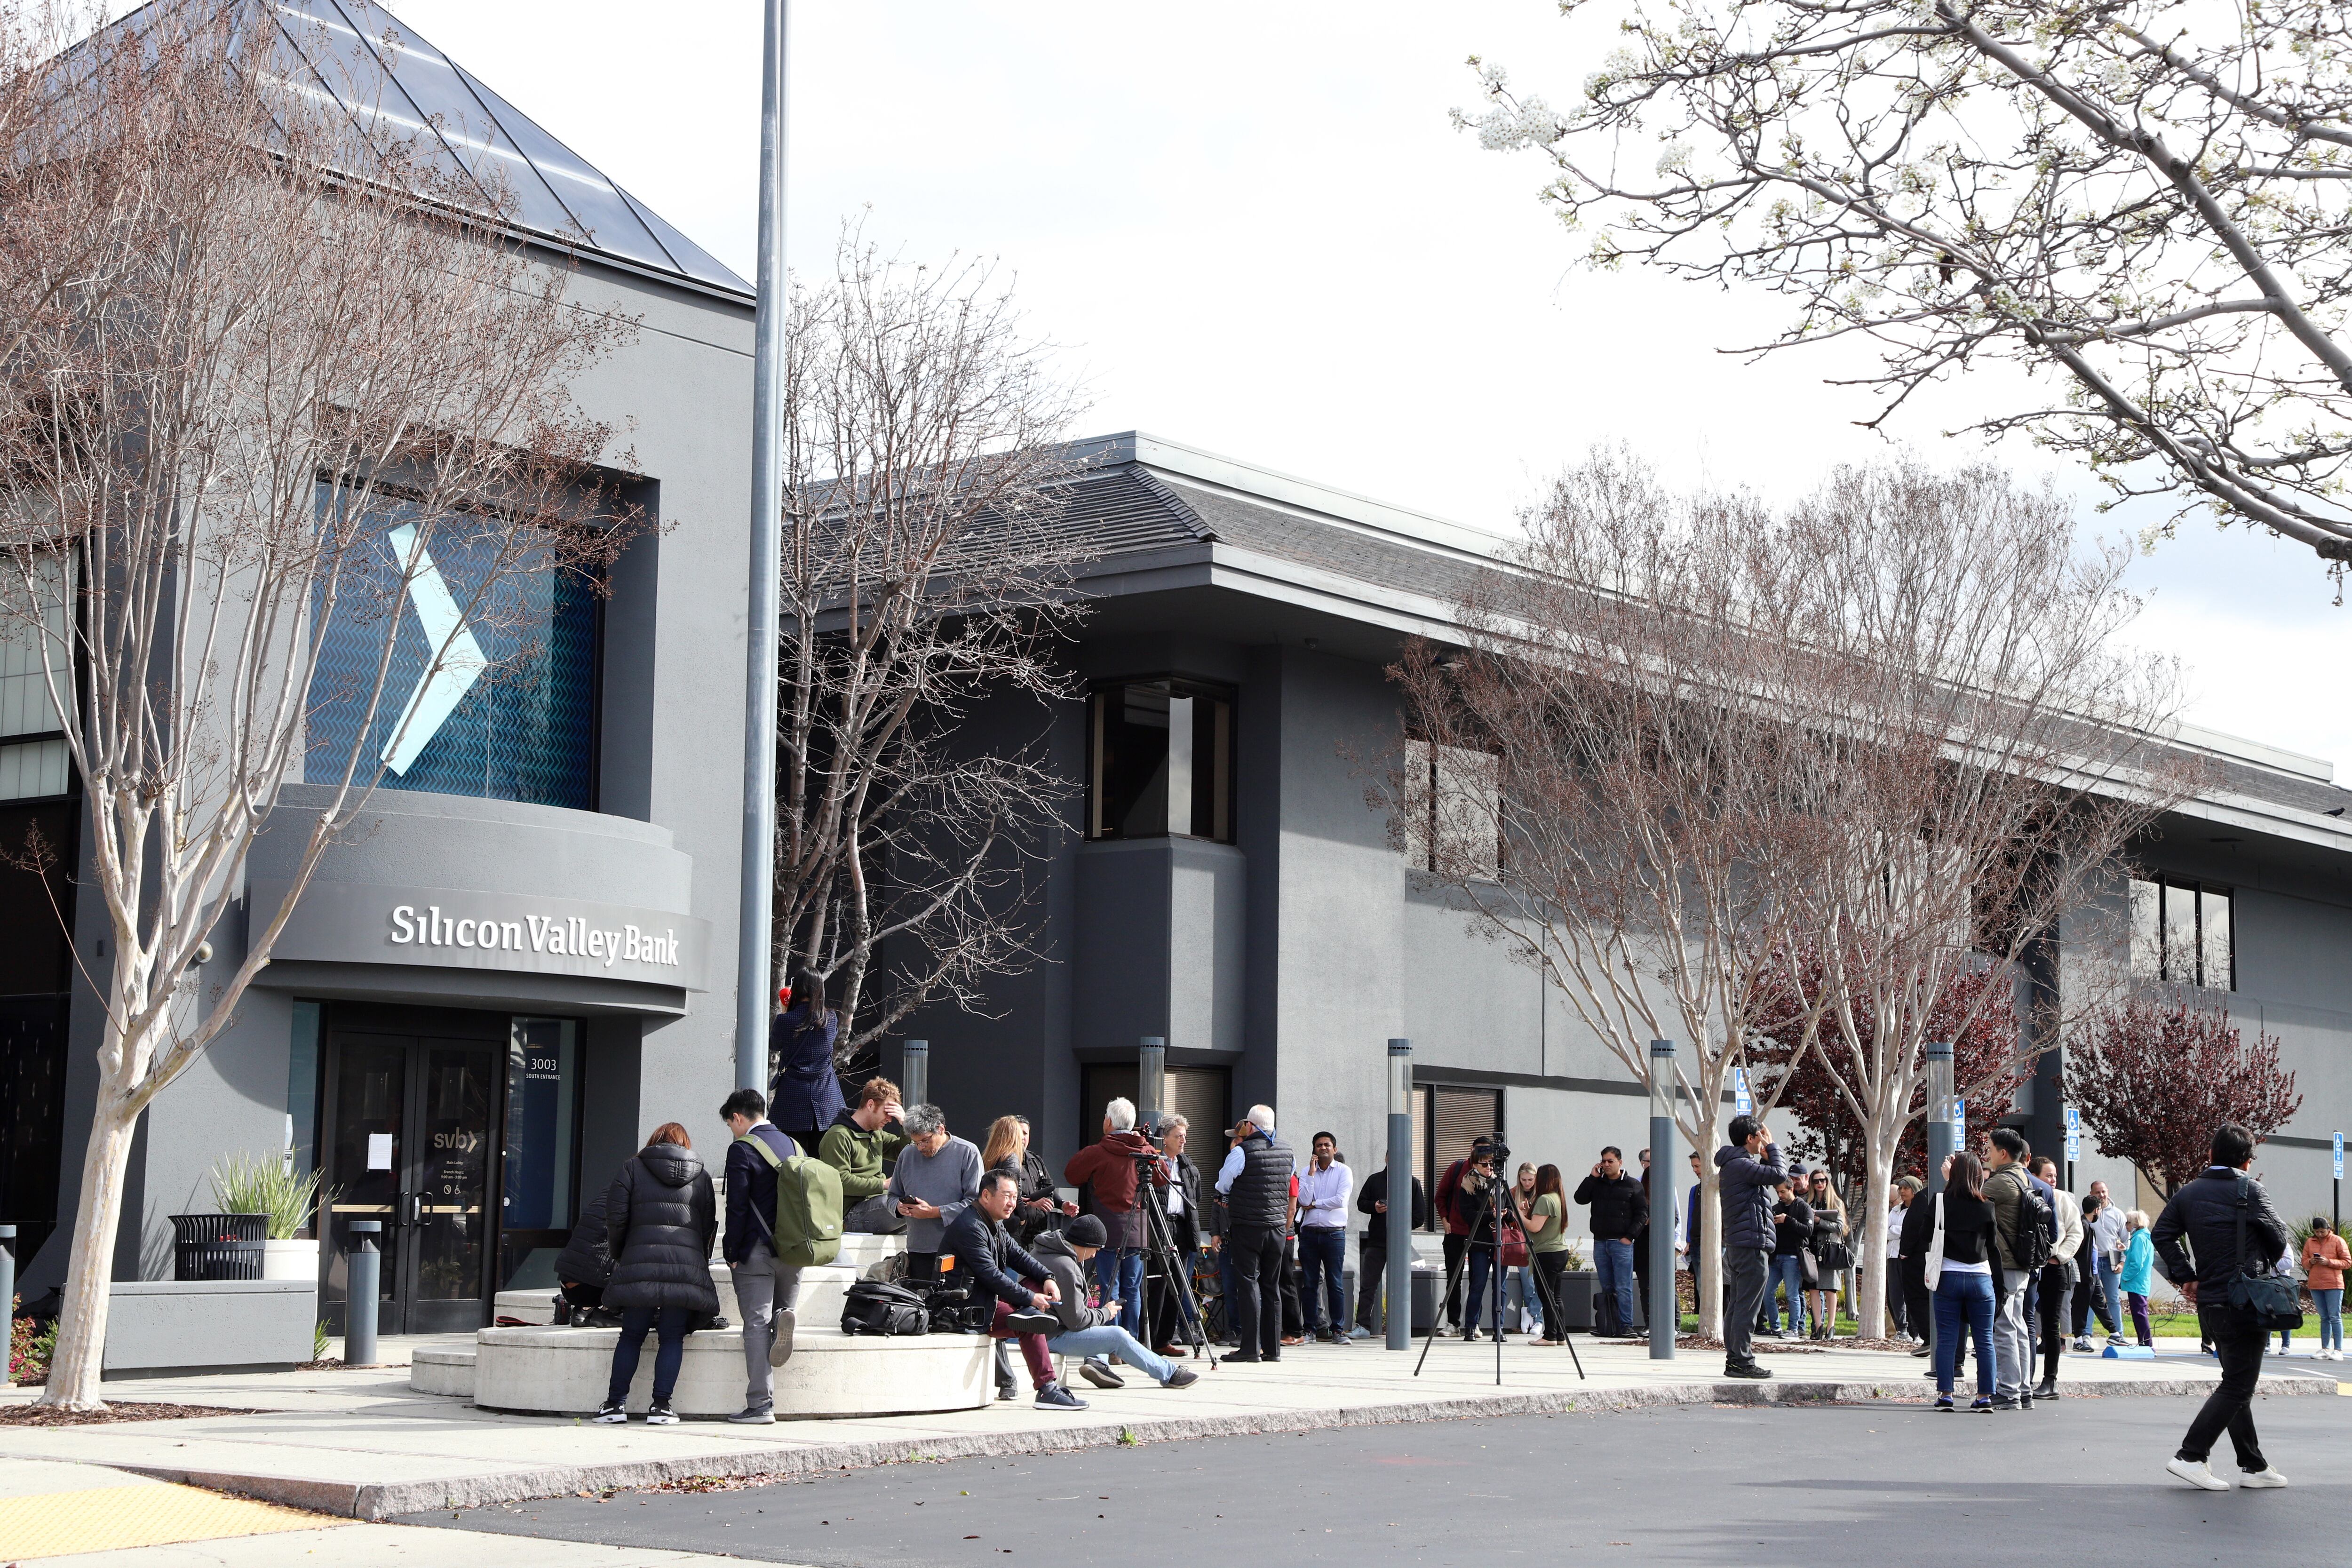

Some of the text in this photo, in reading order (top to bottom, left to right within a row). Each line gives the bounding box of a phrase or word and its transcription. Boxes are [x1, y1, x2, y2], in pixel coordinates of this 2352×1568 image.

[391, 906, 679, 968] Silicon Valley Bank
[531, 1059, 556, 1071] 3003
[434, 1127, 467, 1149] svb
